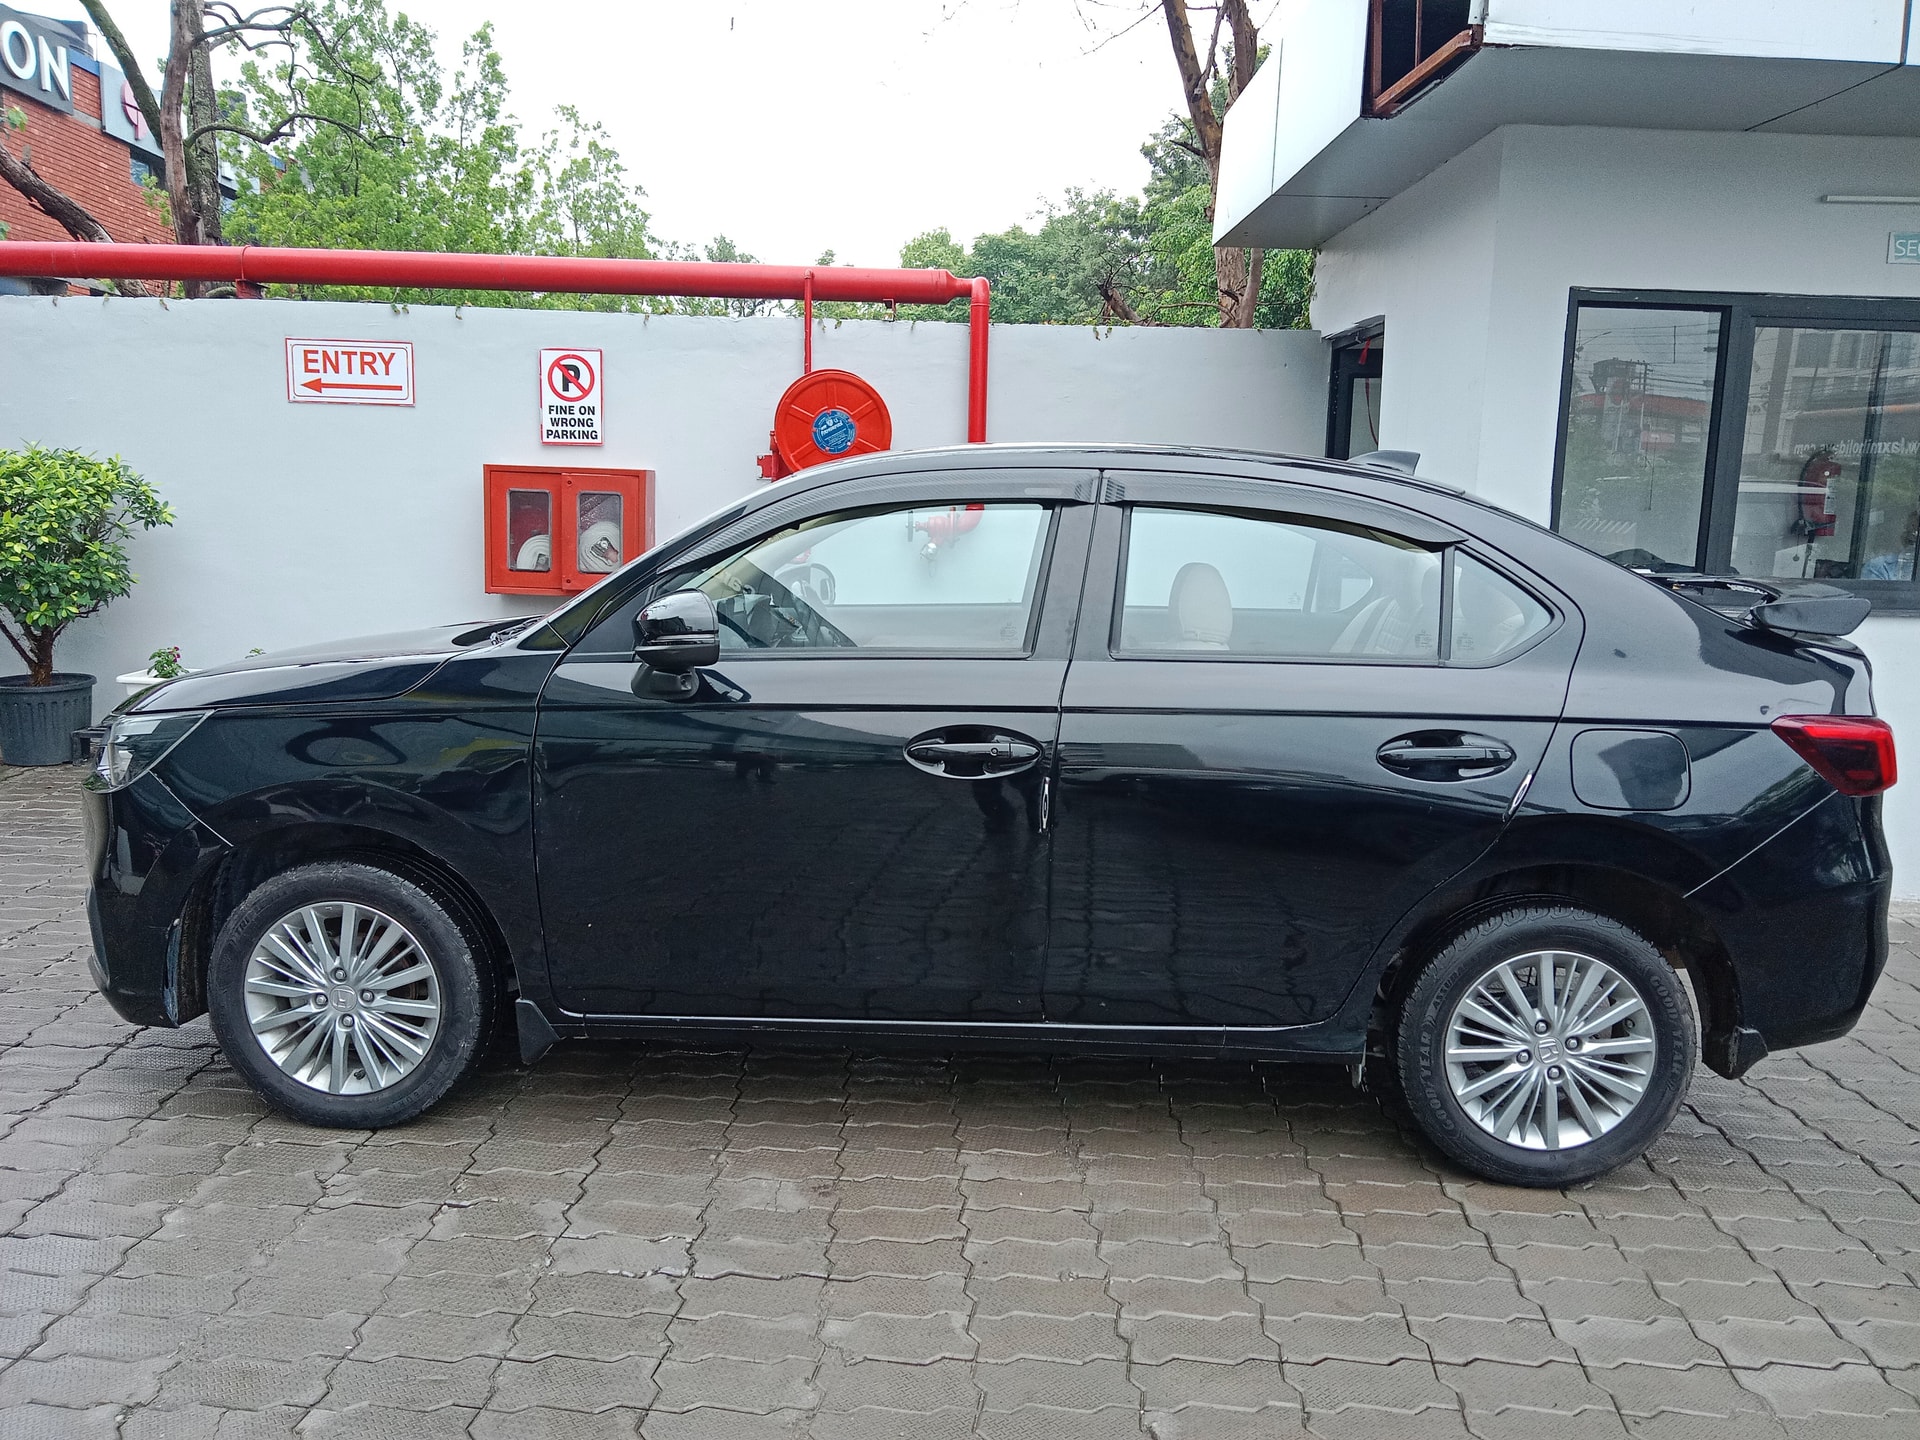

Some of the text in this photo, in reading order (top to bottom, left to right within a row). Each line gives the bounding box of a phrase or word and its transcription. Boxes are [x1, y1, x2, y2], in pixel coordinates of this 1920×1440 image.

[1, 20, 71, 101] ON
[1895, 239, 1920, 257] SE
[303, 349, 396, 376] ENTRY
[562, 364, 580, 392] P
[548, 405, 595, 415] FINE ON
[550, 417, 594, 428] WRONG
[546, 429, 598, 440] PARKING
